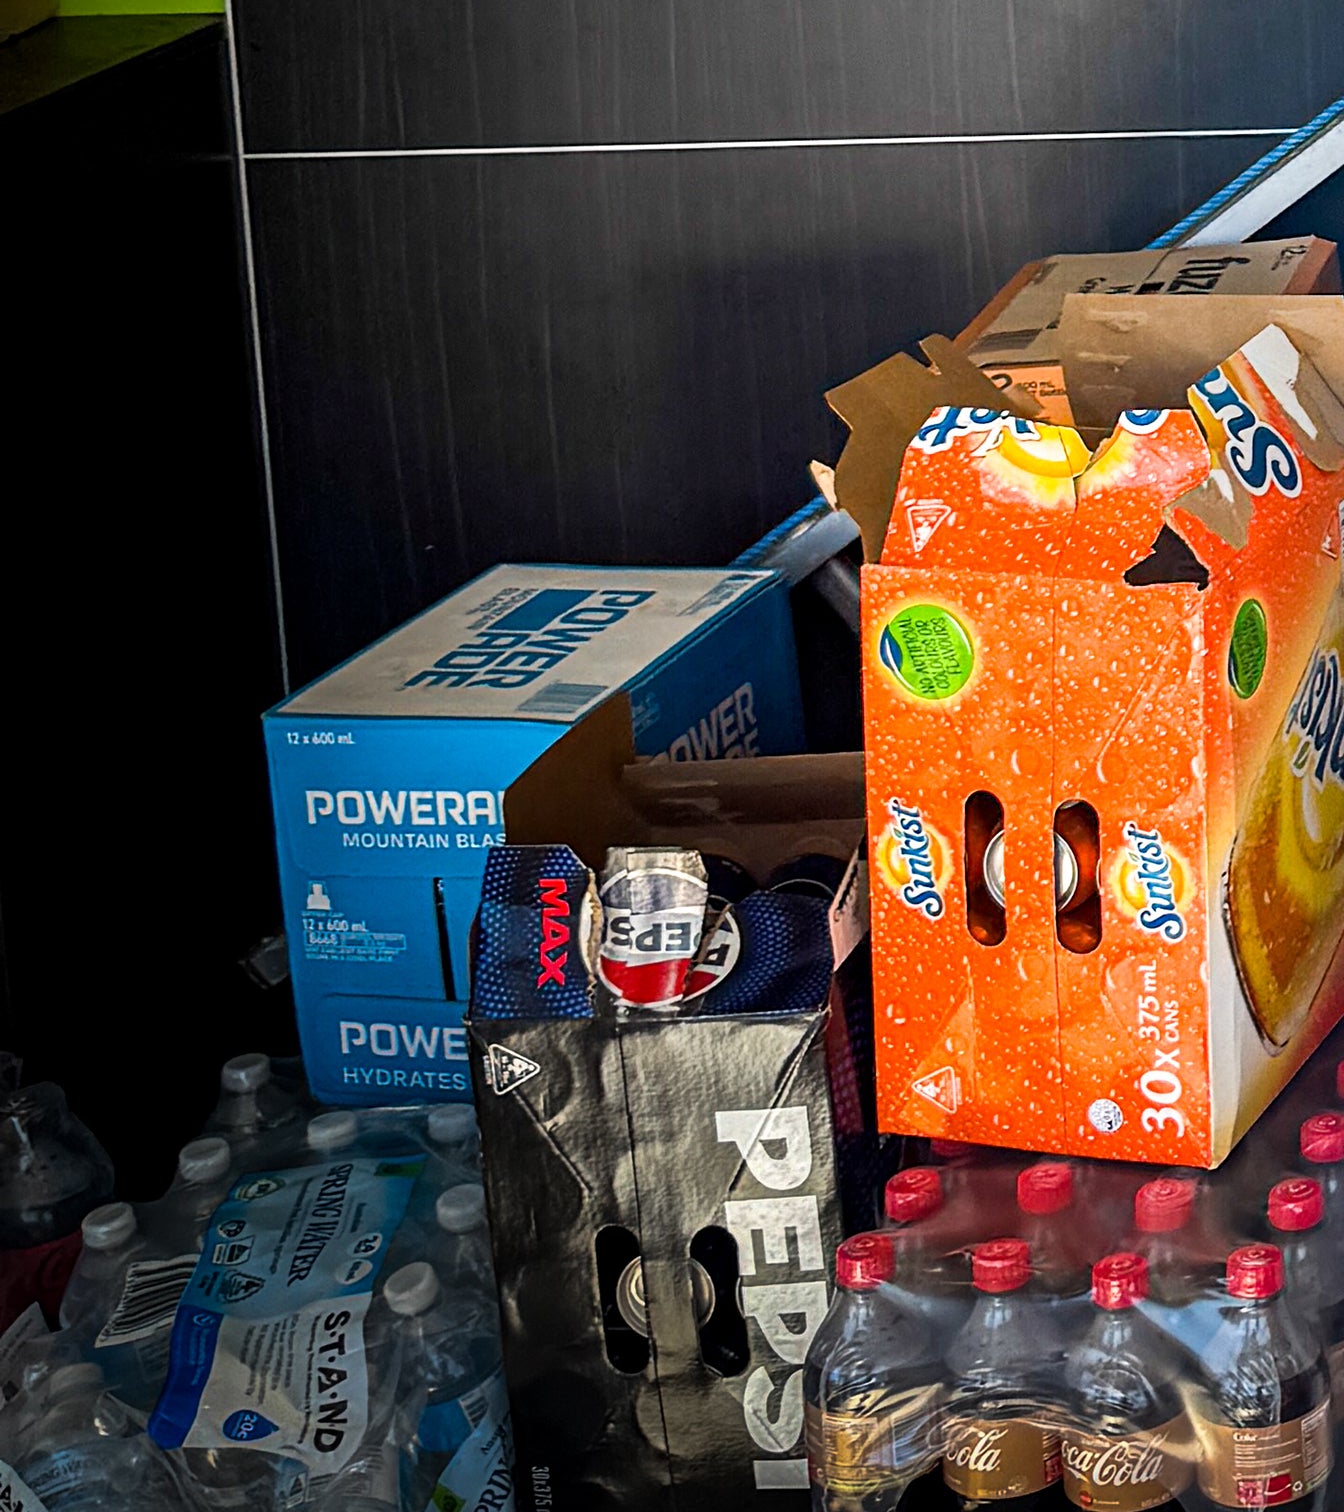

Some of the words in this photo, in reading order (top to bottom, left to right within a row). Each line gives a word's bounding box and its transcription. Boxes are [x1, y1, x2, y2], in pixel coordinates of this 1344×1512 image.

[467, 589, 657, 690] POWER
[915, 620, 933, 636] OR
[404, 631, 524, 688] ADE
[919, 677, 936, 694] NO
[655, 682, 758, 761] OWER
[305, 790, 506, 826] POWERA
[343, 833, 450, 848] MOUNTAIN
[890, 798, 943, 919] Sunkist
[1125, 824, 1184, 941] Sunkist
[538, 878, 571, 988] MAX
[1164, 1000, 1180, 1042] CANS
[343, 1067, 467, 1091] HYDRATES
[311, 1162, 355, 1218] SPRING
[287, 1220, 341, 1288] WATER
[715, 1105, 831, 1490] PEPSI
